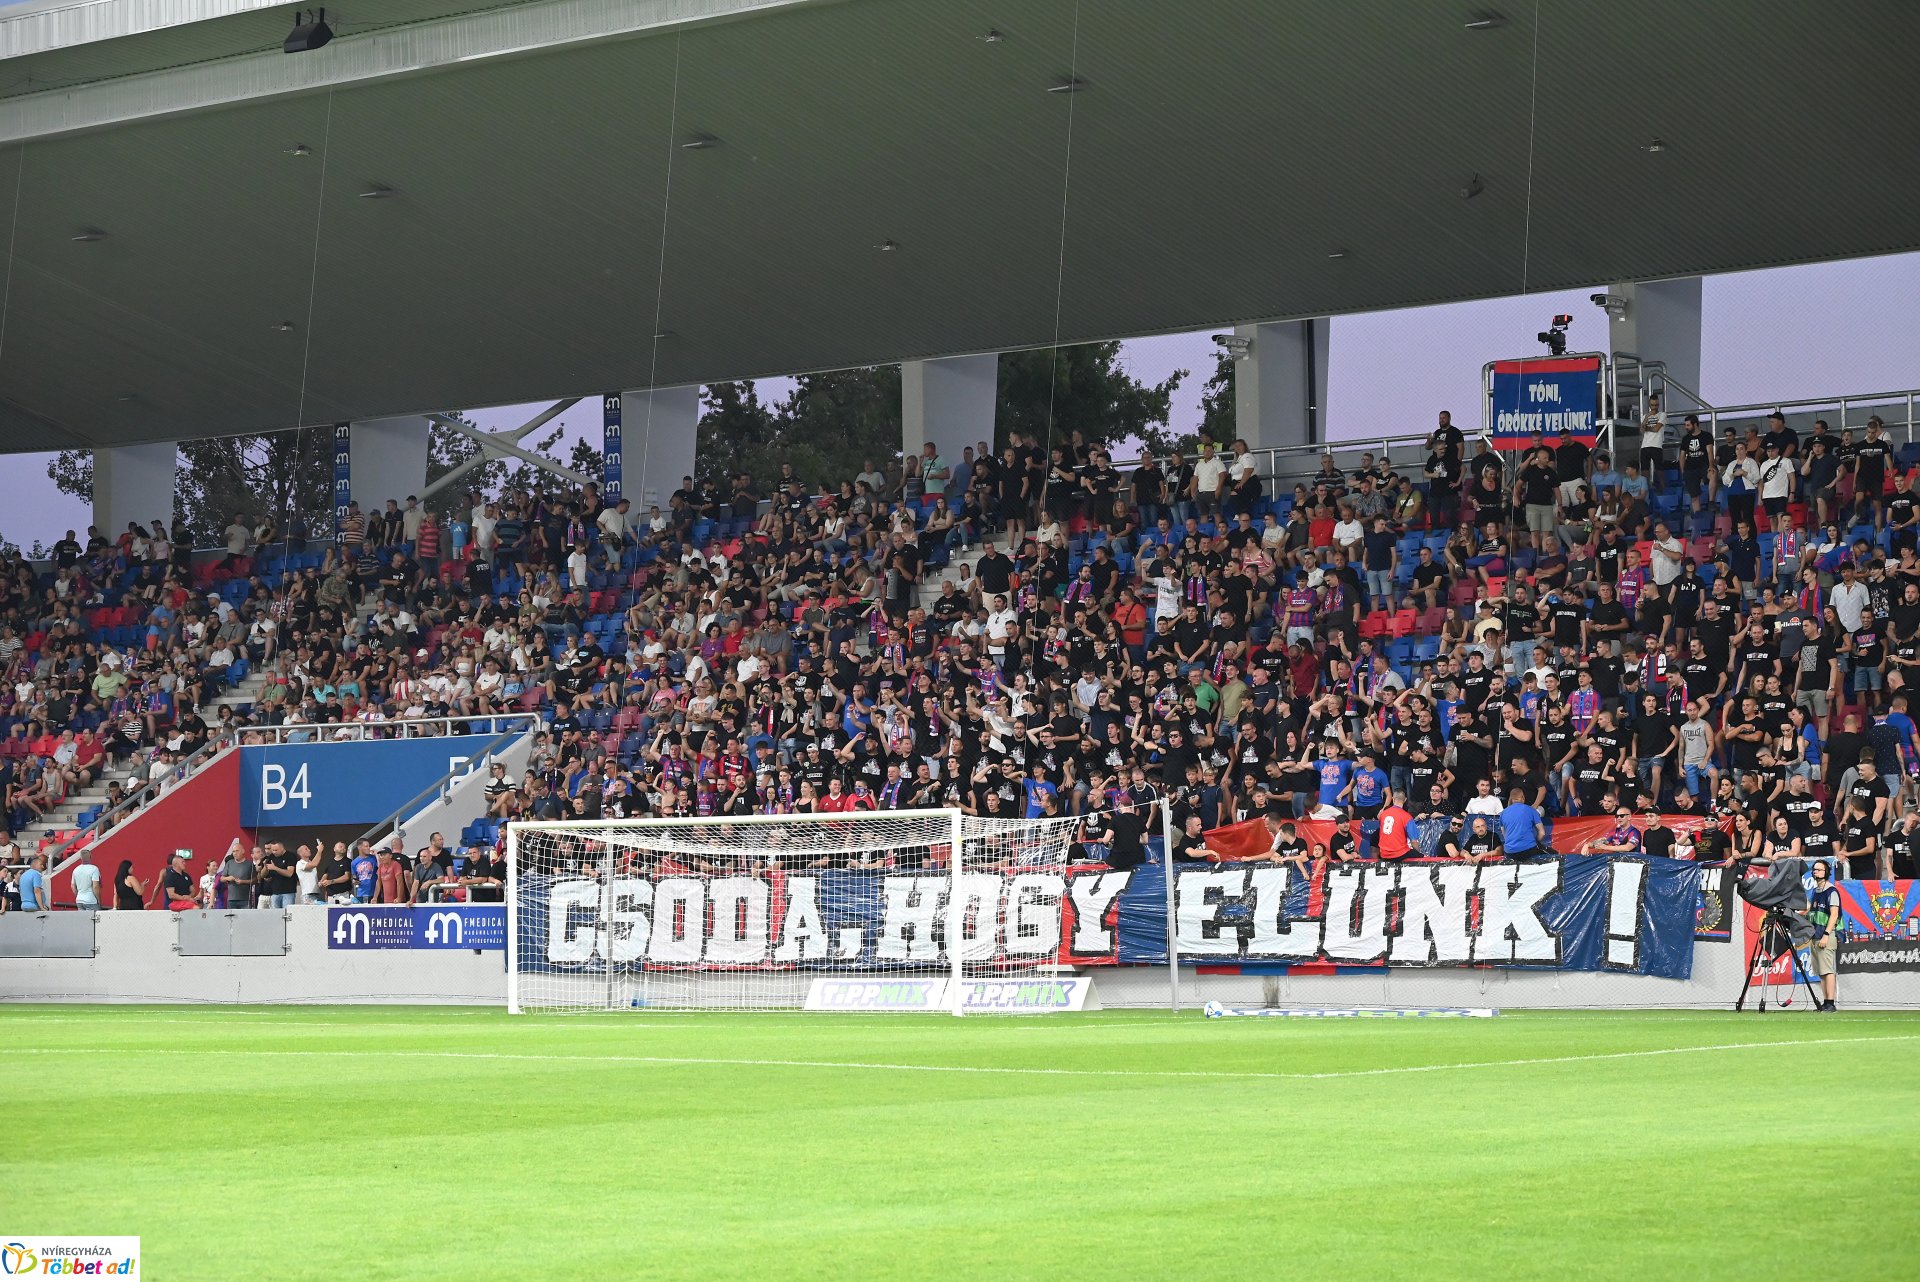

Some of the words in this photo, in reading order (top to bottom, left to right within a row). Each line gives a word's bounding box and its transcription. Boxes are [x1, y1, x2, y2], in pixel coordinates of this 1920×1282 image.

[1529, 380, 1562, 404] TÓNI,
[1498, 408, 1542, 432] ÖRÖKKÉ
[1545, 408, 1592, 431] VELÜNK!
[262, 762, 312, 810] B4
[1383, 815, 1395, 835] 8
[371, 918, 414, 928] FMEDICAL
[547, 876, 863, 963] CSODA,
[876, 870, 1135, 961] HOGY
[1839, 947, 1920, 964] NYÍREGYHÁ
